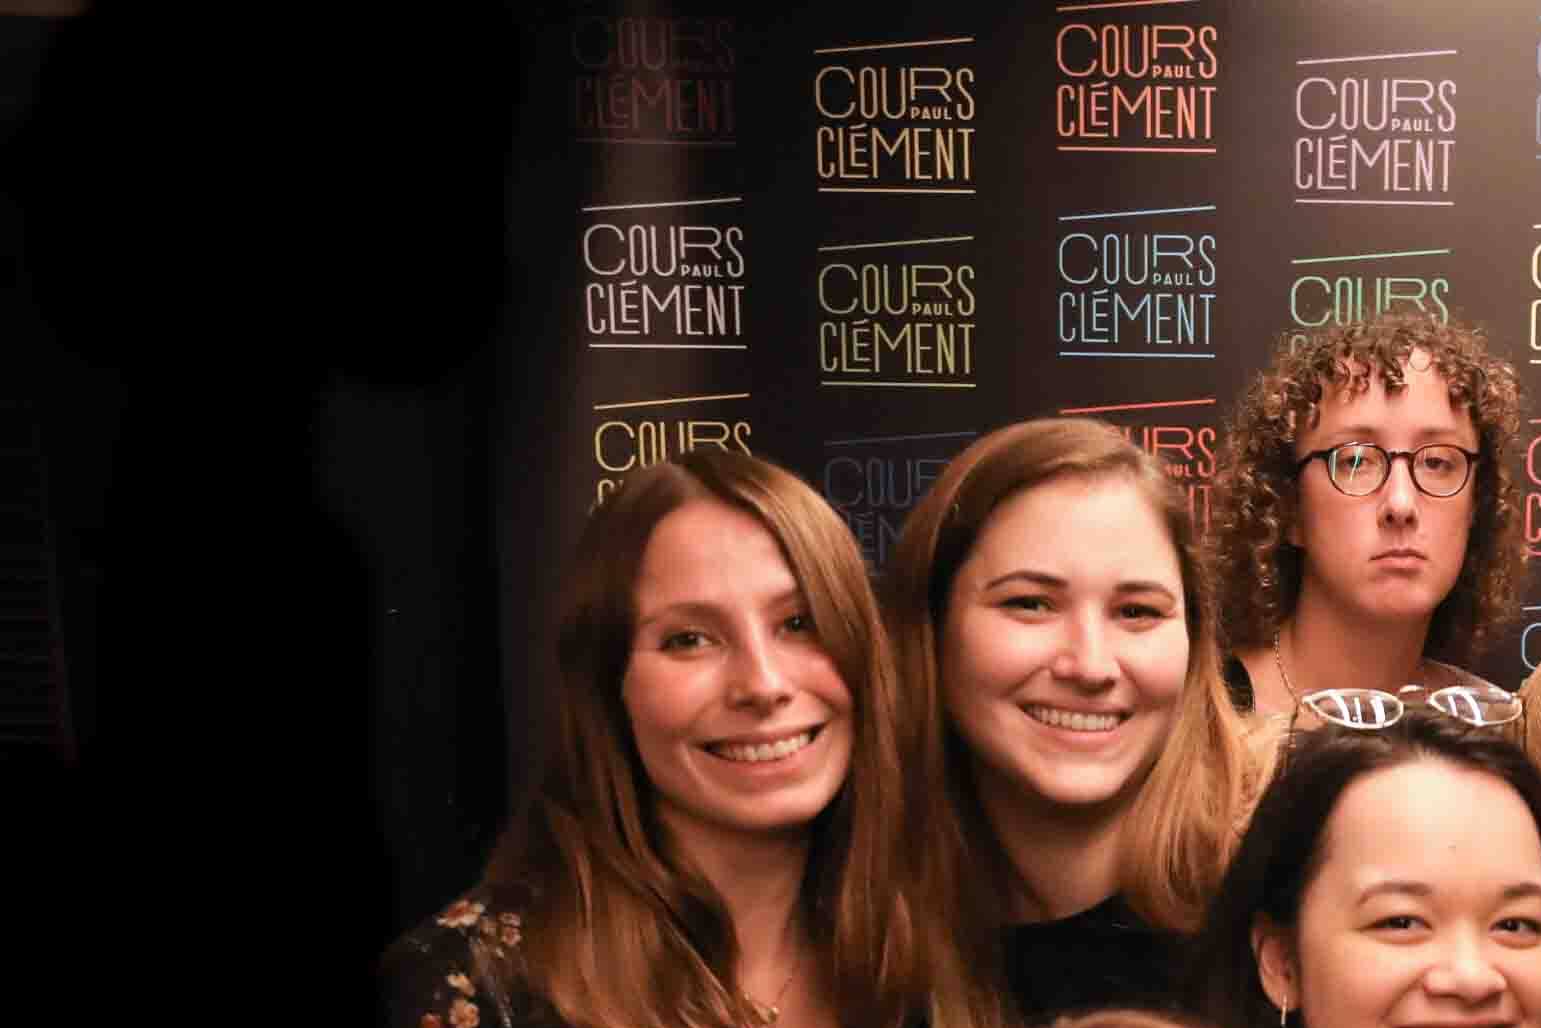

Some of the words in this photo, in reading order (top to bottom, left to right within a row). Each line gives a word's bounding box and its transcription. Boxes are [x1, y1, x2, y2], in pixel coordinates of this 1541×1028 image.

[1056, 23, 1217, 79] COURS
[1152, 65, 1195, 79] PAUL
[815, 64, 975, 121] COURS
[911, 107, 953, 121] PAUL
[1056, 81, 1217, 140] CLÉMENT
[1296, 77, 1457, 132] COURS
[816, 123, 976, 181] CLÉMENT
[1391, 118, 1433, 132] PAUL
[1295, 135, 1456, 192] CLÉMENT
[583, 223, 745, 278] COURS
[680, 264, 722, 278] PAUL
[1058, 232, 1216, 286] COURS
[818, 263, 975, 316] COURS
[1152, 272, 1194, 287] PAUL
[586, 281, 745, 336] CLÉMENT
[911, 303, 953, 316] PAUL
[1058, 289, 1216, 345] CLÉMENT
[819, 320, 976, 374] CLÉMENT
